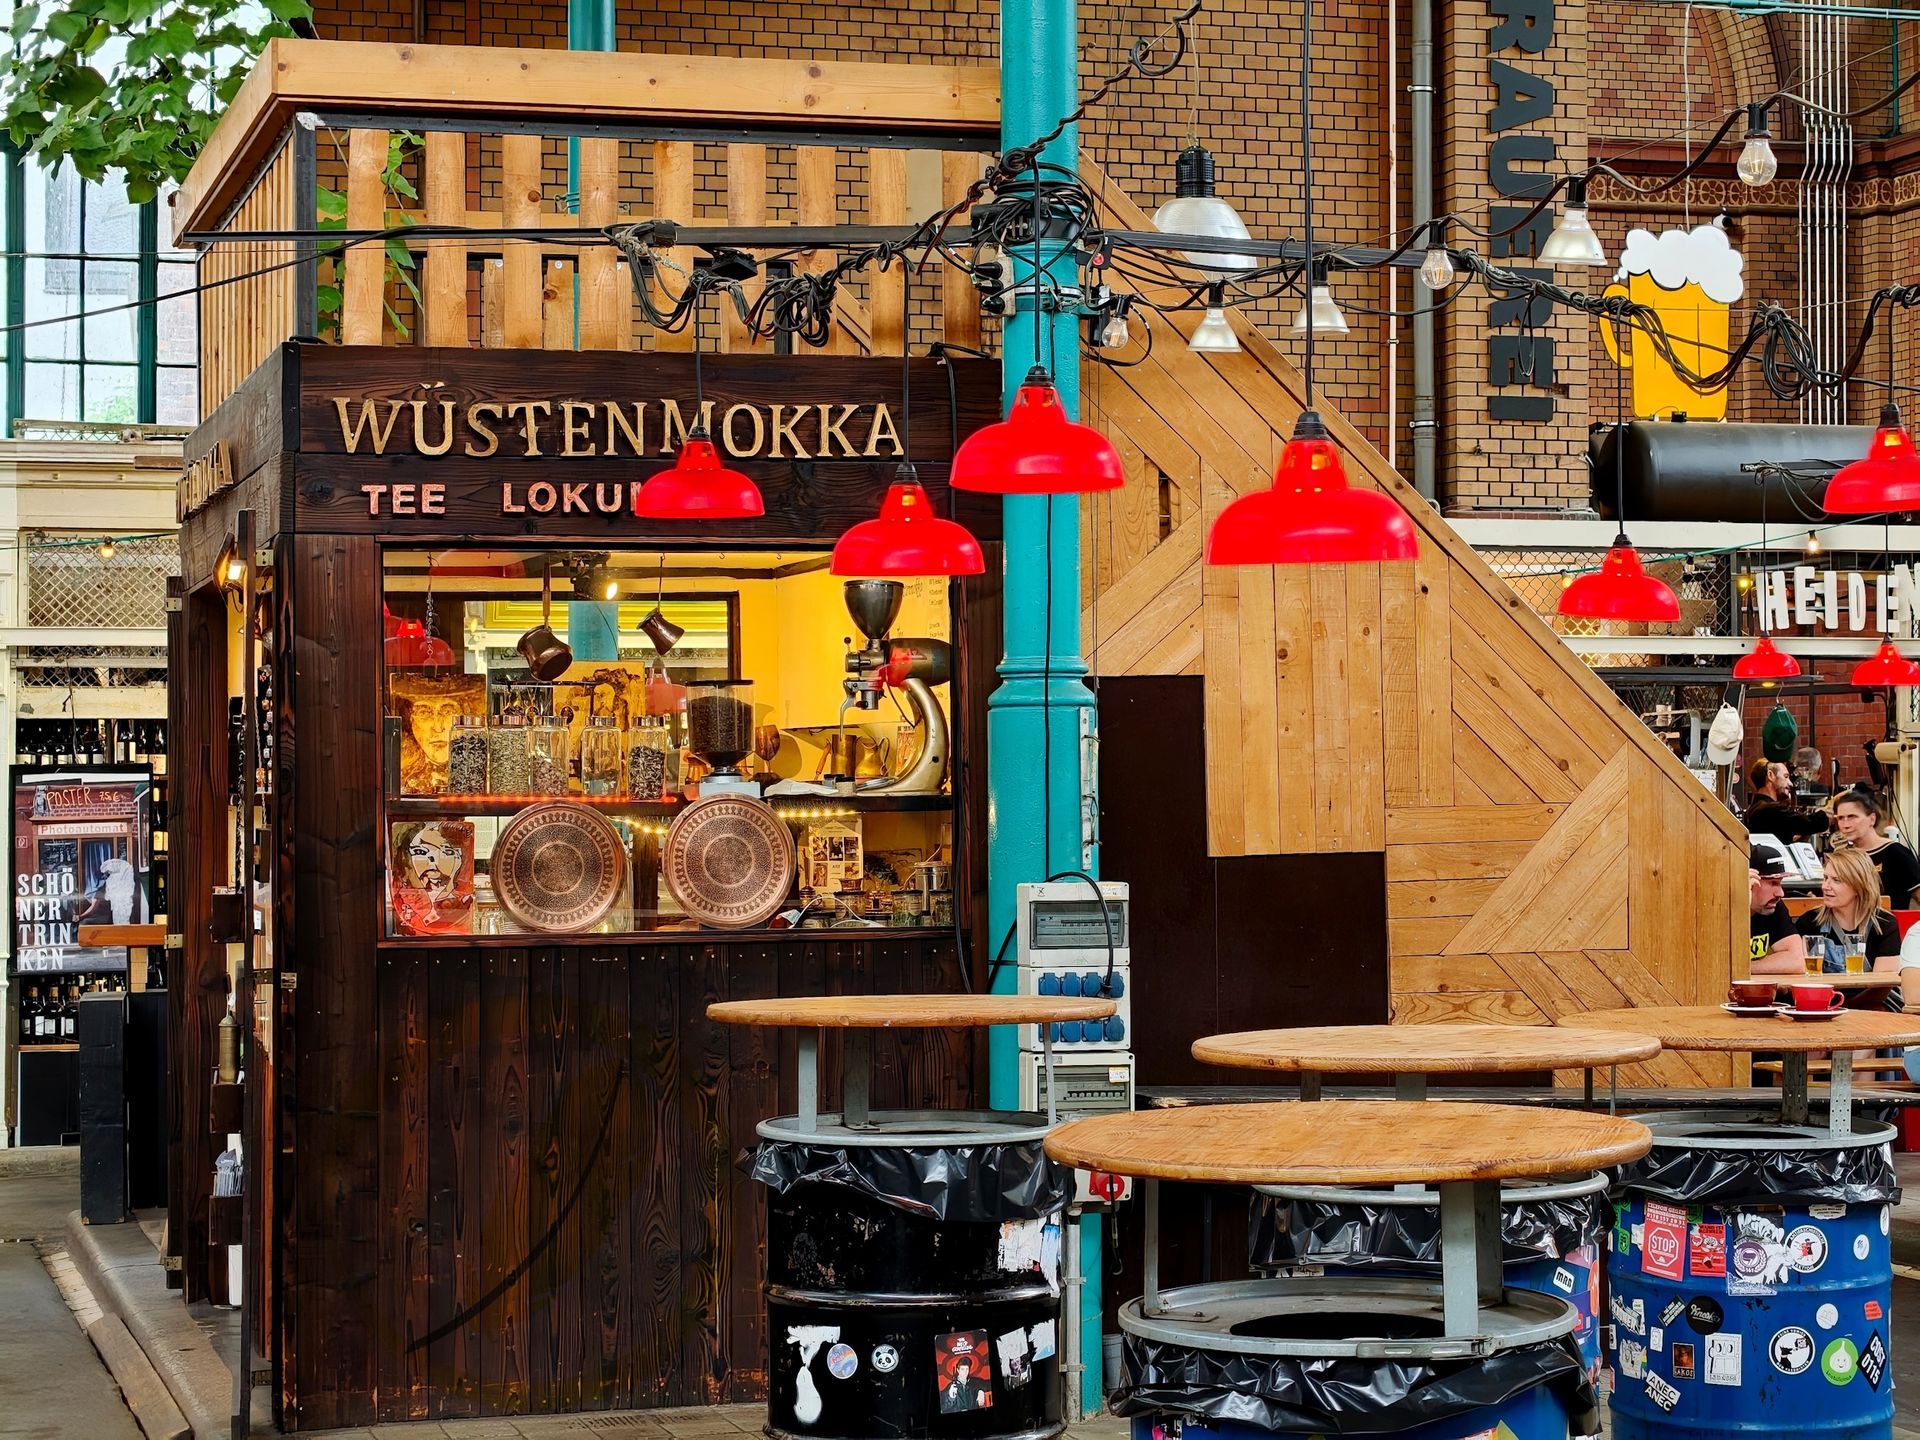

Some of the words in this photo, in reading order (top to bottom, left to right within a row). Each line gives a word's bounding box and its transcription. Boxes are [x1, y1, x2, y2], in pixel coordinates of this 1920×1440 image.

[360, 483, 446, 515] TEE
[47, 786, 93, 810] POSTER
[41, 823, 124, 835] Photoautomat
[17, 868, 74, 896] SCHÖ
[18, 898, 62, 921] NER
[19, 923, 71, 946] TRIN
[19, 948, 63, 971] KEN
[1651, 1235, 1676, 1253] STOP
[1861, 1353, 1881, 1385] 0115
[1645, 1386, 1672, 1411] ANEC
[1649, 1377, 1677, 1400] ANEC
